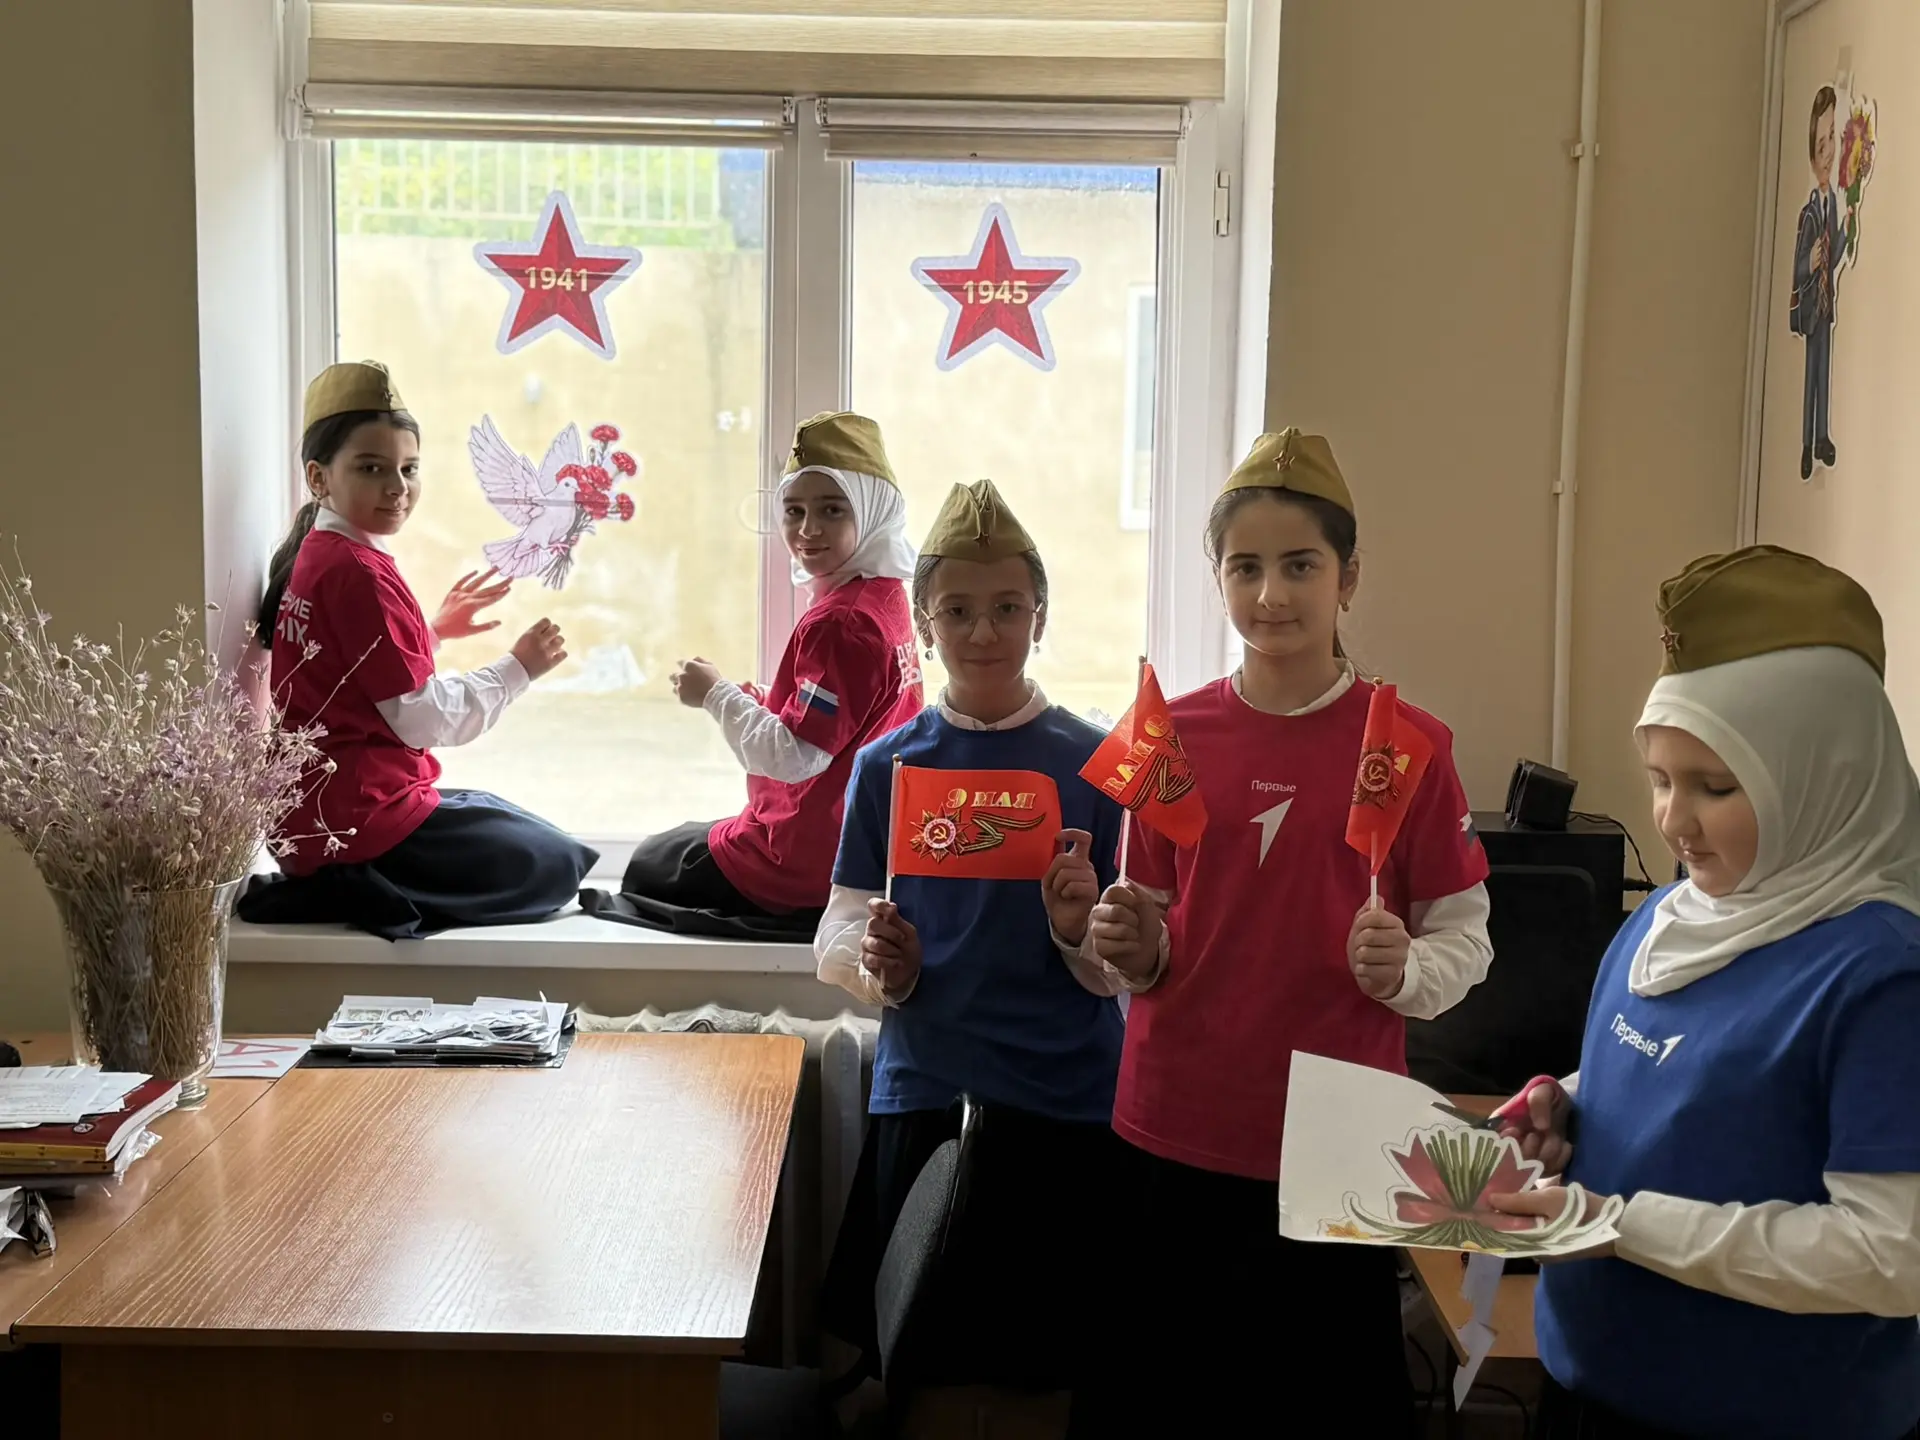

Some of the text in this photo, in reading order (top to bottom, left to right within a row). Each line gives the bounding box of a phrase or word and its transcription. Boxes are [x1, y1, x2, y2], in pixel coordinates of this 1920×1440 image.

[525, 267, 588, 292] 1941
[963, 280, 1029, 304] 1945
[946, 788, 1036, 809] 9 МАЯ
[1251, 780, 1297, 793] Первые
[1610, 1013, 1659, 1056] Первые
